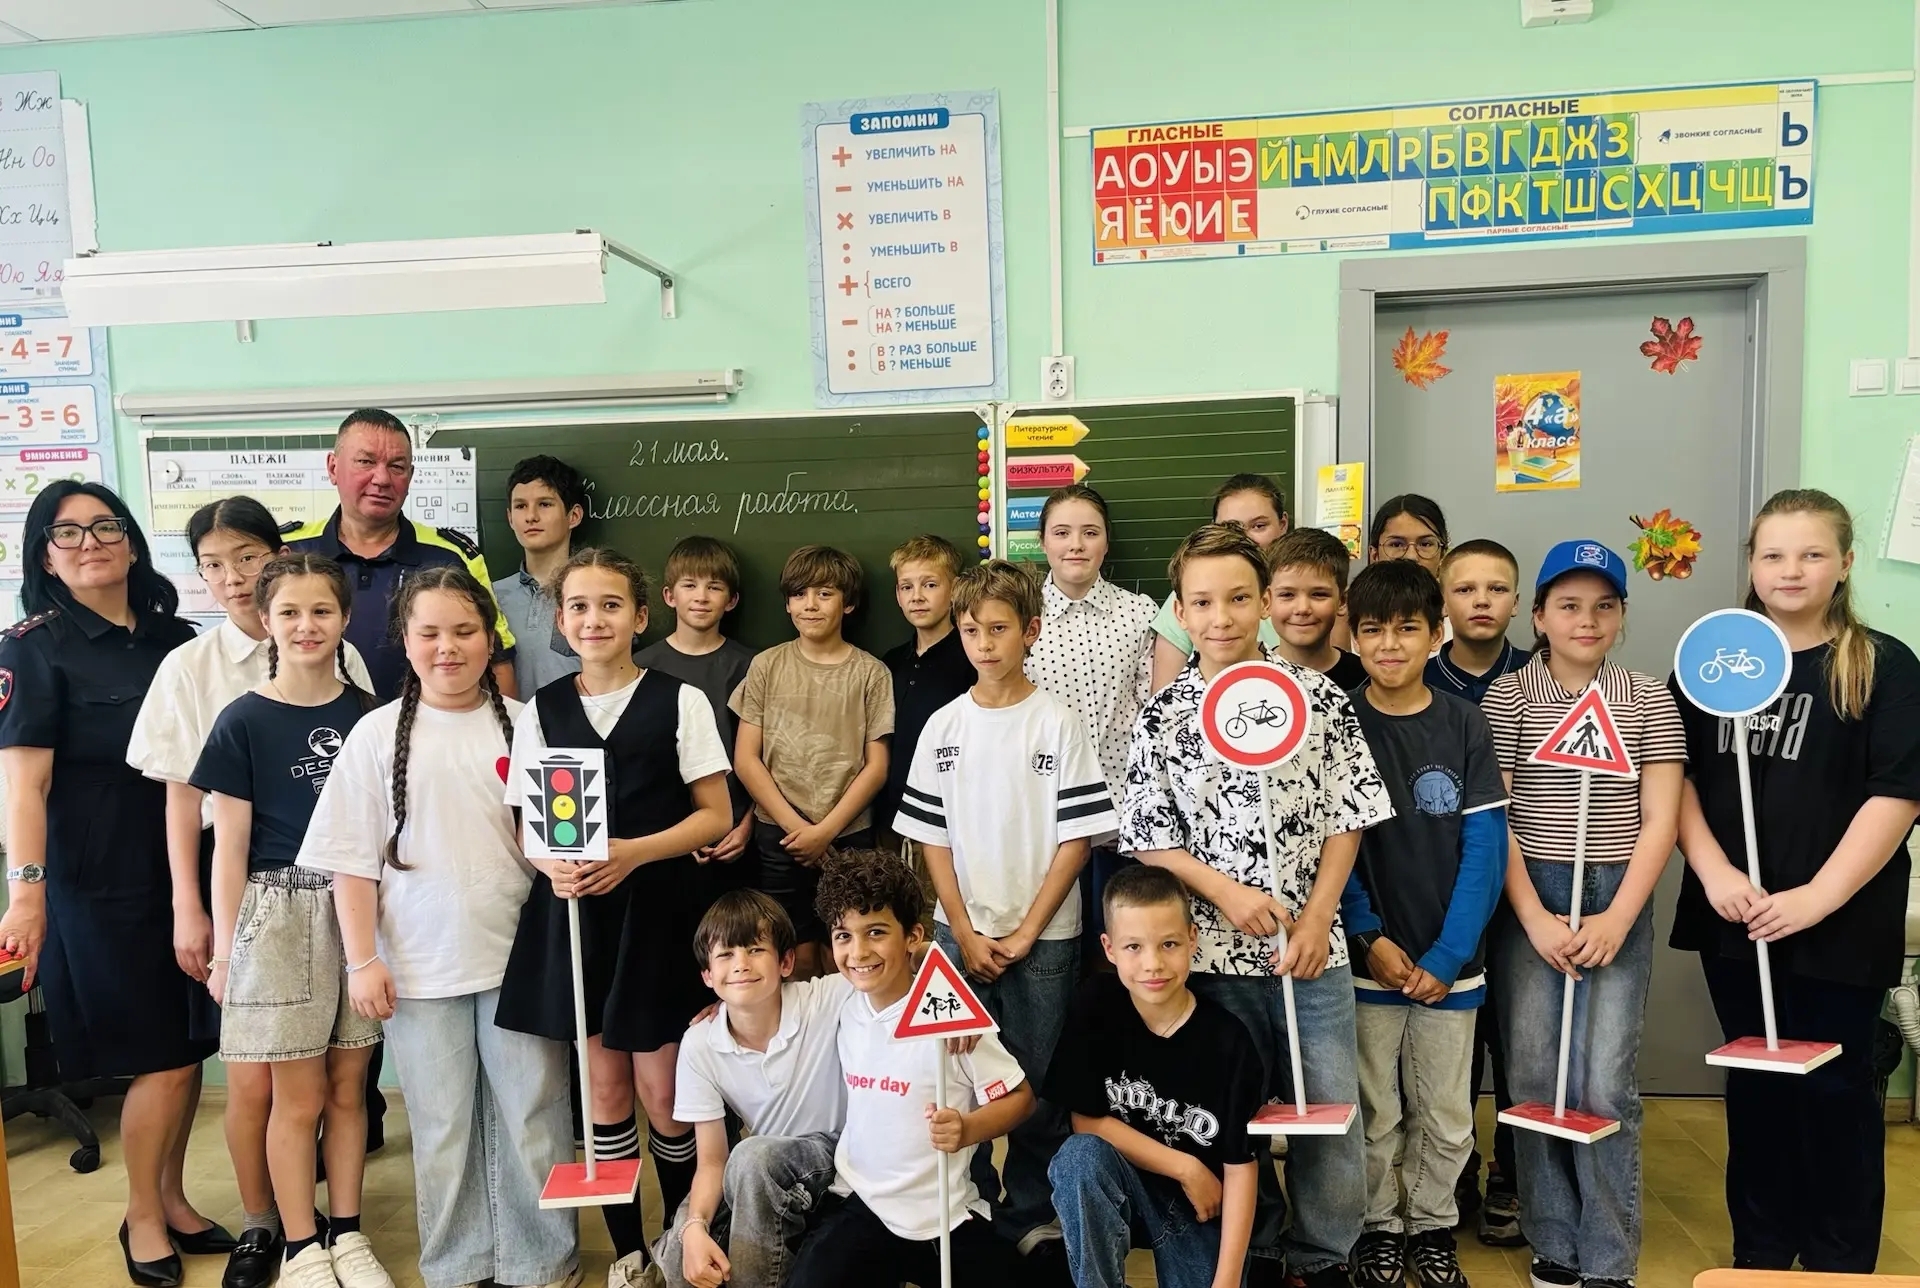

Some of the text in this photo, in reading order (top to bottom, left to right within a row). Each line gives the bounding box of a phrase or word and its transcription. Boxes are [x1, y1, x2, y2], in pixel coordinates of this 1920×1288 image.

[1449, 99, 1579, 122] СОГЛАСНЫЕ
[860, 113, 938, 131] ЗАПОМНИ
[1127, 124, 1223, 143] ГЛАСНЫЕ
[1674, 127, 1763, 139] ЗВОНКИЕ СОГЛАСНЫЕ
[865, 145, 936, 160] УВЕЛИЧИТЬ
[940, 143, 957, 155] НА
[867, 176, 964, 193] УМЕНЬШИТЬ НА
[1341, 204, 1389, 213] СОГЛАСНЫЕ
[868, 210, 938, 225] УВЕЛИЧИТЬ
[943, 209, 951, 221] В
[1521, 223, 1569, 232] СОГЛАСНЫЕ
[870, 241, 958, 257] УМЕНЬШИТЬ В
[874, 277, 912, 289] ВСЕГО
[875, 304, 956, 319] НА ? БОЛЬШЕ
[876, 318, 957, 334] НА ? МЕНЬШЕ
[11, 338, 29, 359] 4
[57, 336, 73, 358] 7
[877, 341, 977, 357] В ? РАЗ БОЛЬШЕ
[878, 356, 951, 371] В ? МЕНЬШЕ
[17, 406, 34, 428] 3
[63, 404, 80, 426] 6
[1523, 398, 1544, 425] 4
[1013, 424, 1068, 433] Литературное
[1527, 435, 1577, 448] класс
[25, 451, 83, 460] УМНОЖЕНИЕ
[230, 454, 286, 465] ПАДЕЖИ
[629, 438, 729, 467] 21 мая.
[1009, 465, 1071, 474] ФИЗКУЛЬТУРА
[24, 473, 40, 495] 2
[733, 472, 858, 535] работа.
[1037, 754, 1054, 770] 72
[880, 1076, 911, 1097] day
